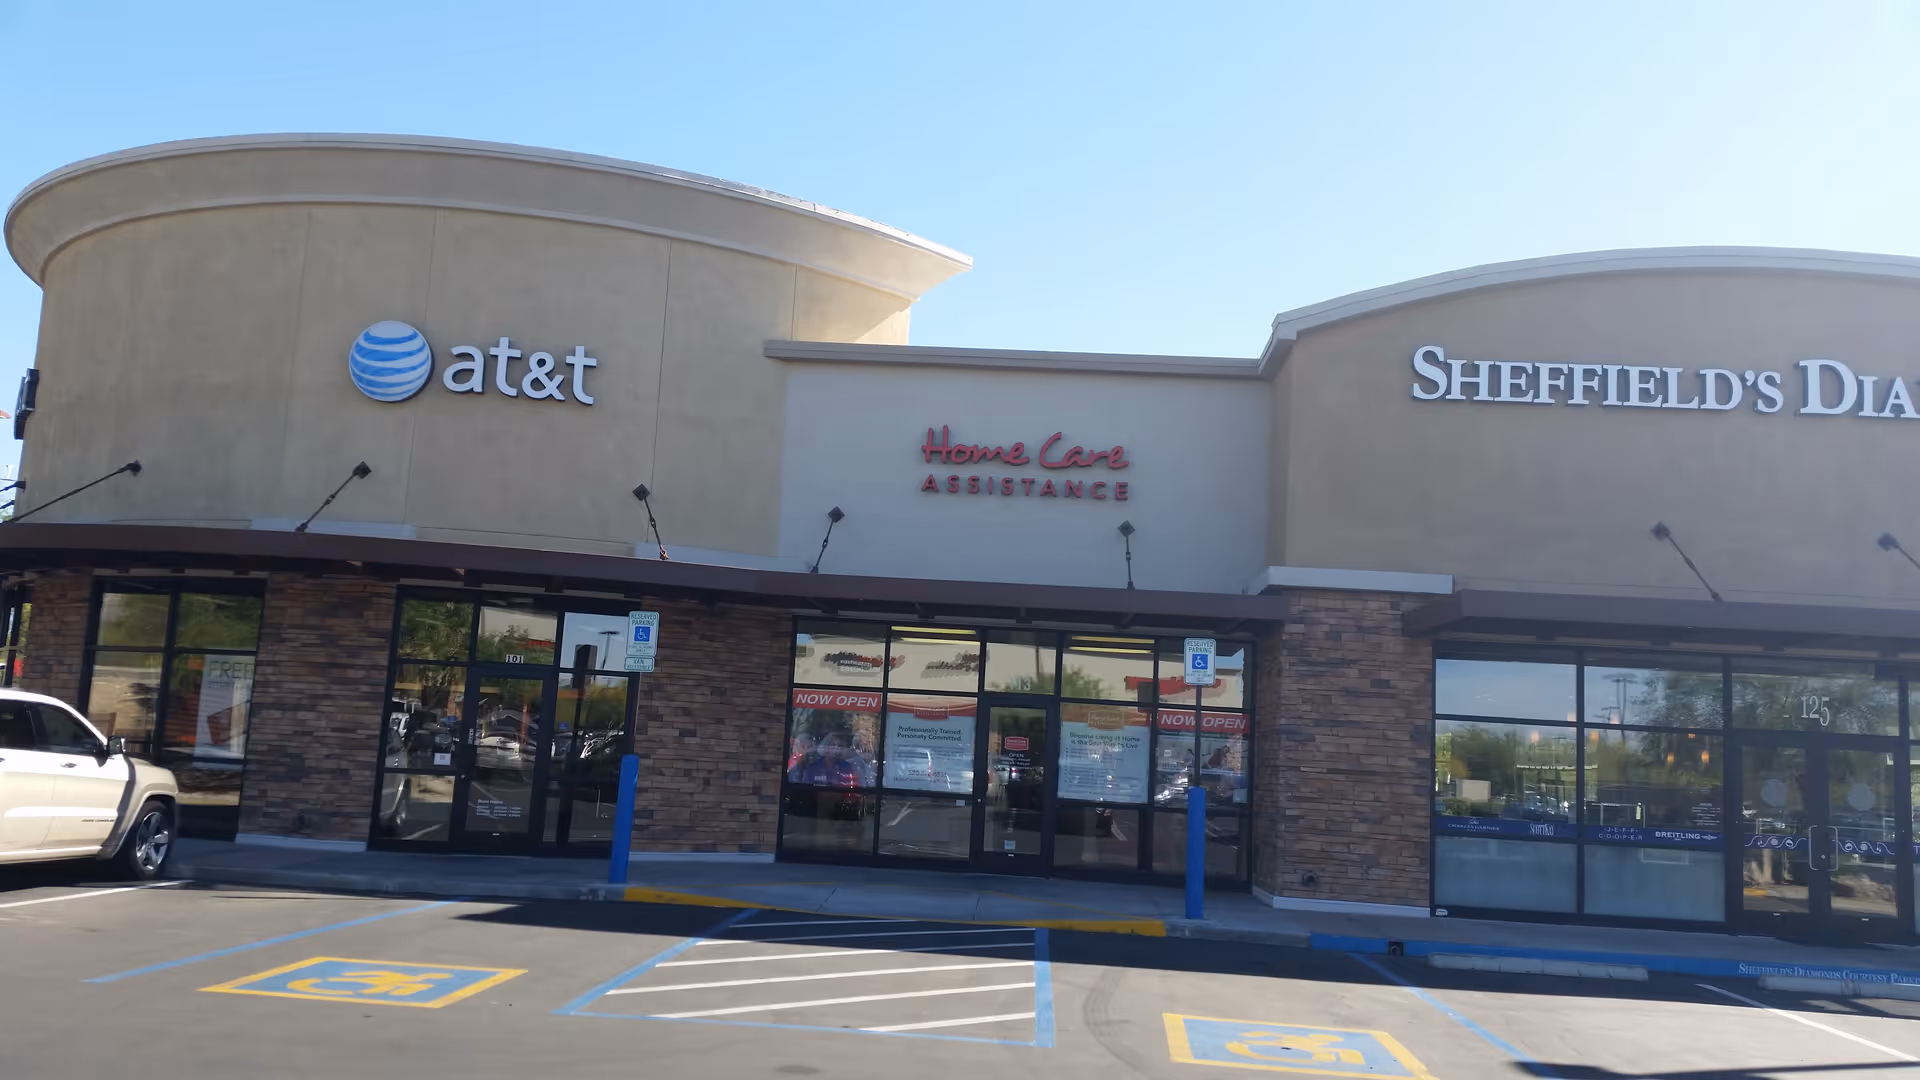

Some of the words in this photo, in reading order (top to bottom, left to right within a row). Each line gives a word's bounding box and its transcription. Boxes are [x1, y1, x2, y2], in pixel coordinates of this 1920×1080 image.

[443, 336, 598, 405] at&t
[1411, 345, 1785, 413] SHEFFIELD'S
[920, 424, 1030, 467] Home
[1039, 431, 1130, 469] Care
[920, 473, 1129, 501] ASSISTANCE
[506, 655, 523, 664] 101
[796, 693, 833, 705] NOW
[836, 695, 878, 708] OPEN
[1800, 695, 1831, 726] 125
[1161, 714, 1196, 726] NOW
[1202, 716, 1246, 729] OPEN
[898, 726, 938, 734] Professionally
[1655, 831, 1700, 840] BREITLING
[1794, 967, 1841, 980] DIAMONDS
[1842, 970, 1889, 983] COURTESY
